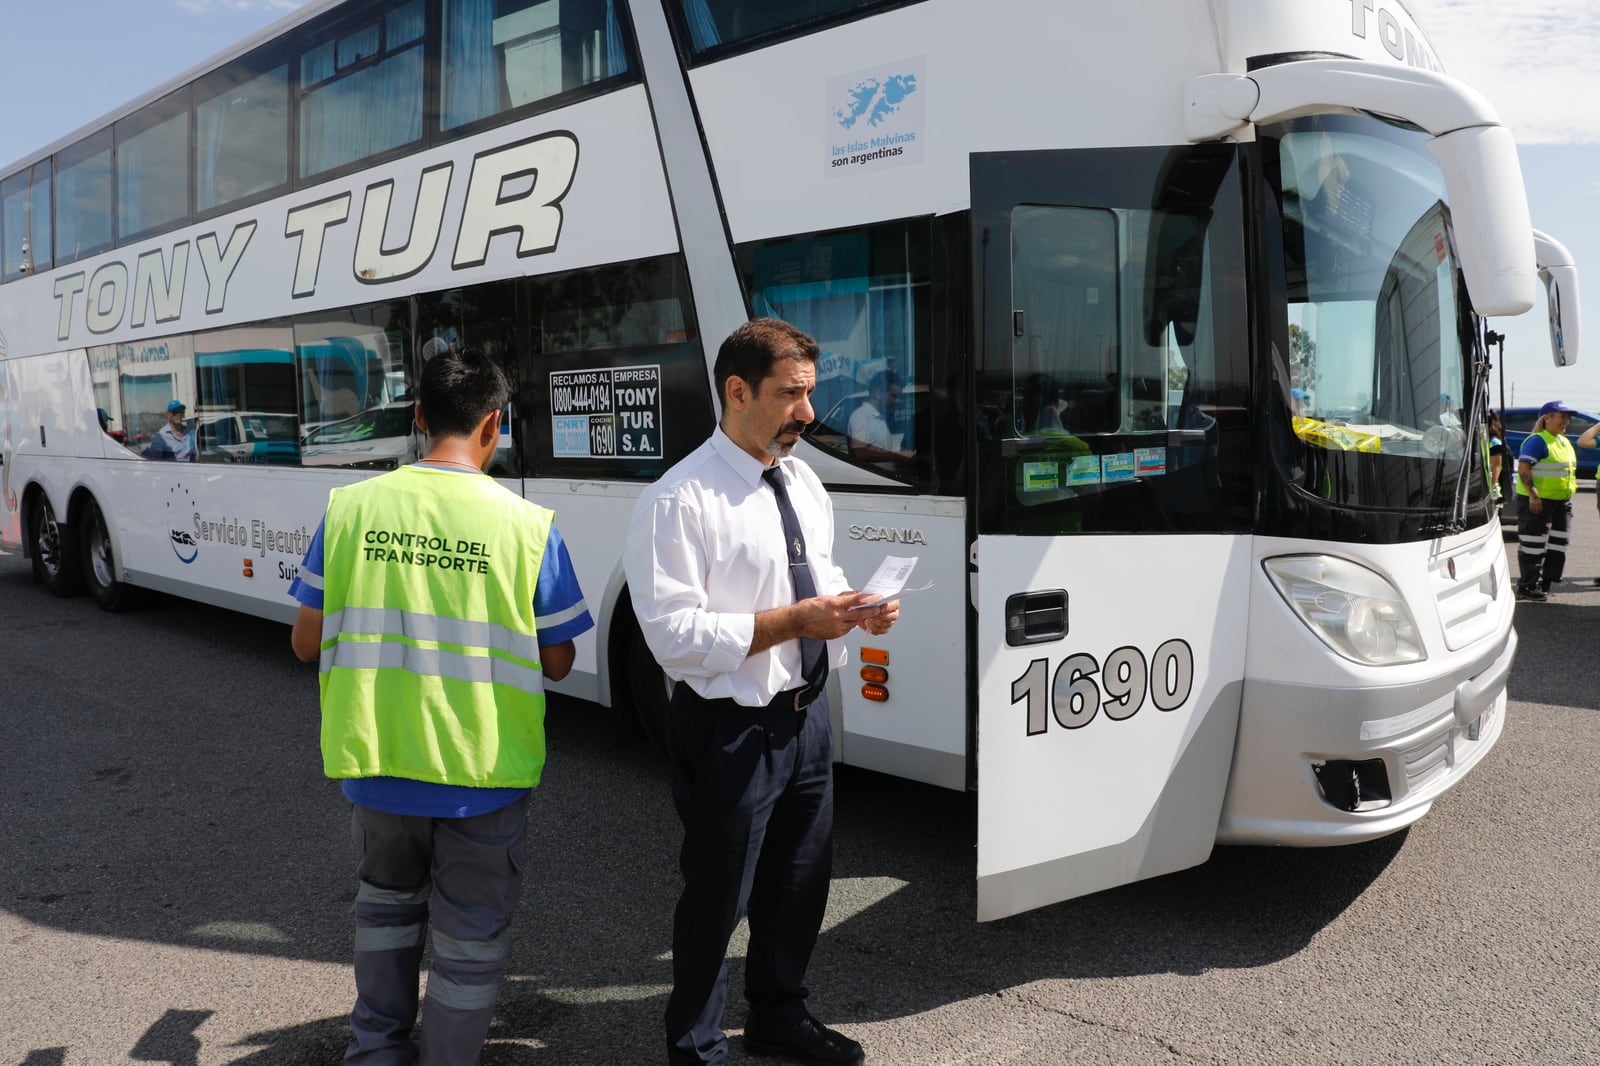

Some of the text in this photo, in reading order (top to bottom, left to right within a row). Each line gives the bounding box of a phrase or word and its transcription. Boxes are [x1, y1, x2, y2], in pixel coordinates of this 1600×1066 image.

[832, 131, 916, 156] las Islas Malvinas
[831, 146, 903, 168] son argentinas
[53, 138, 580, 342] TONY TUR
[552, 372, 611, 386] RECLAMOS AL
[614, 369, 658, 382] EMPRESA
[553, 384, 611, 412] 0800-444-0194
[615, 387, 657, 406] TONY
[556, 419, 586, 430] CNRT
[620, 411, 655, 429] TUR
[591, 424, 614, 455] 1690
[622, 433, 655, 452] S. A.
[193, 512, 248, 547] Servicio
[848, 523, 928, 546] SCANIA
[364, 530, 491, 558] CONTROL DEL
[278, 561, 299, 581] Suit
[363, 547, 489, 575] TRANSPORTE
[1010, 638, 1194, 737] 1690
